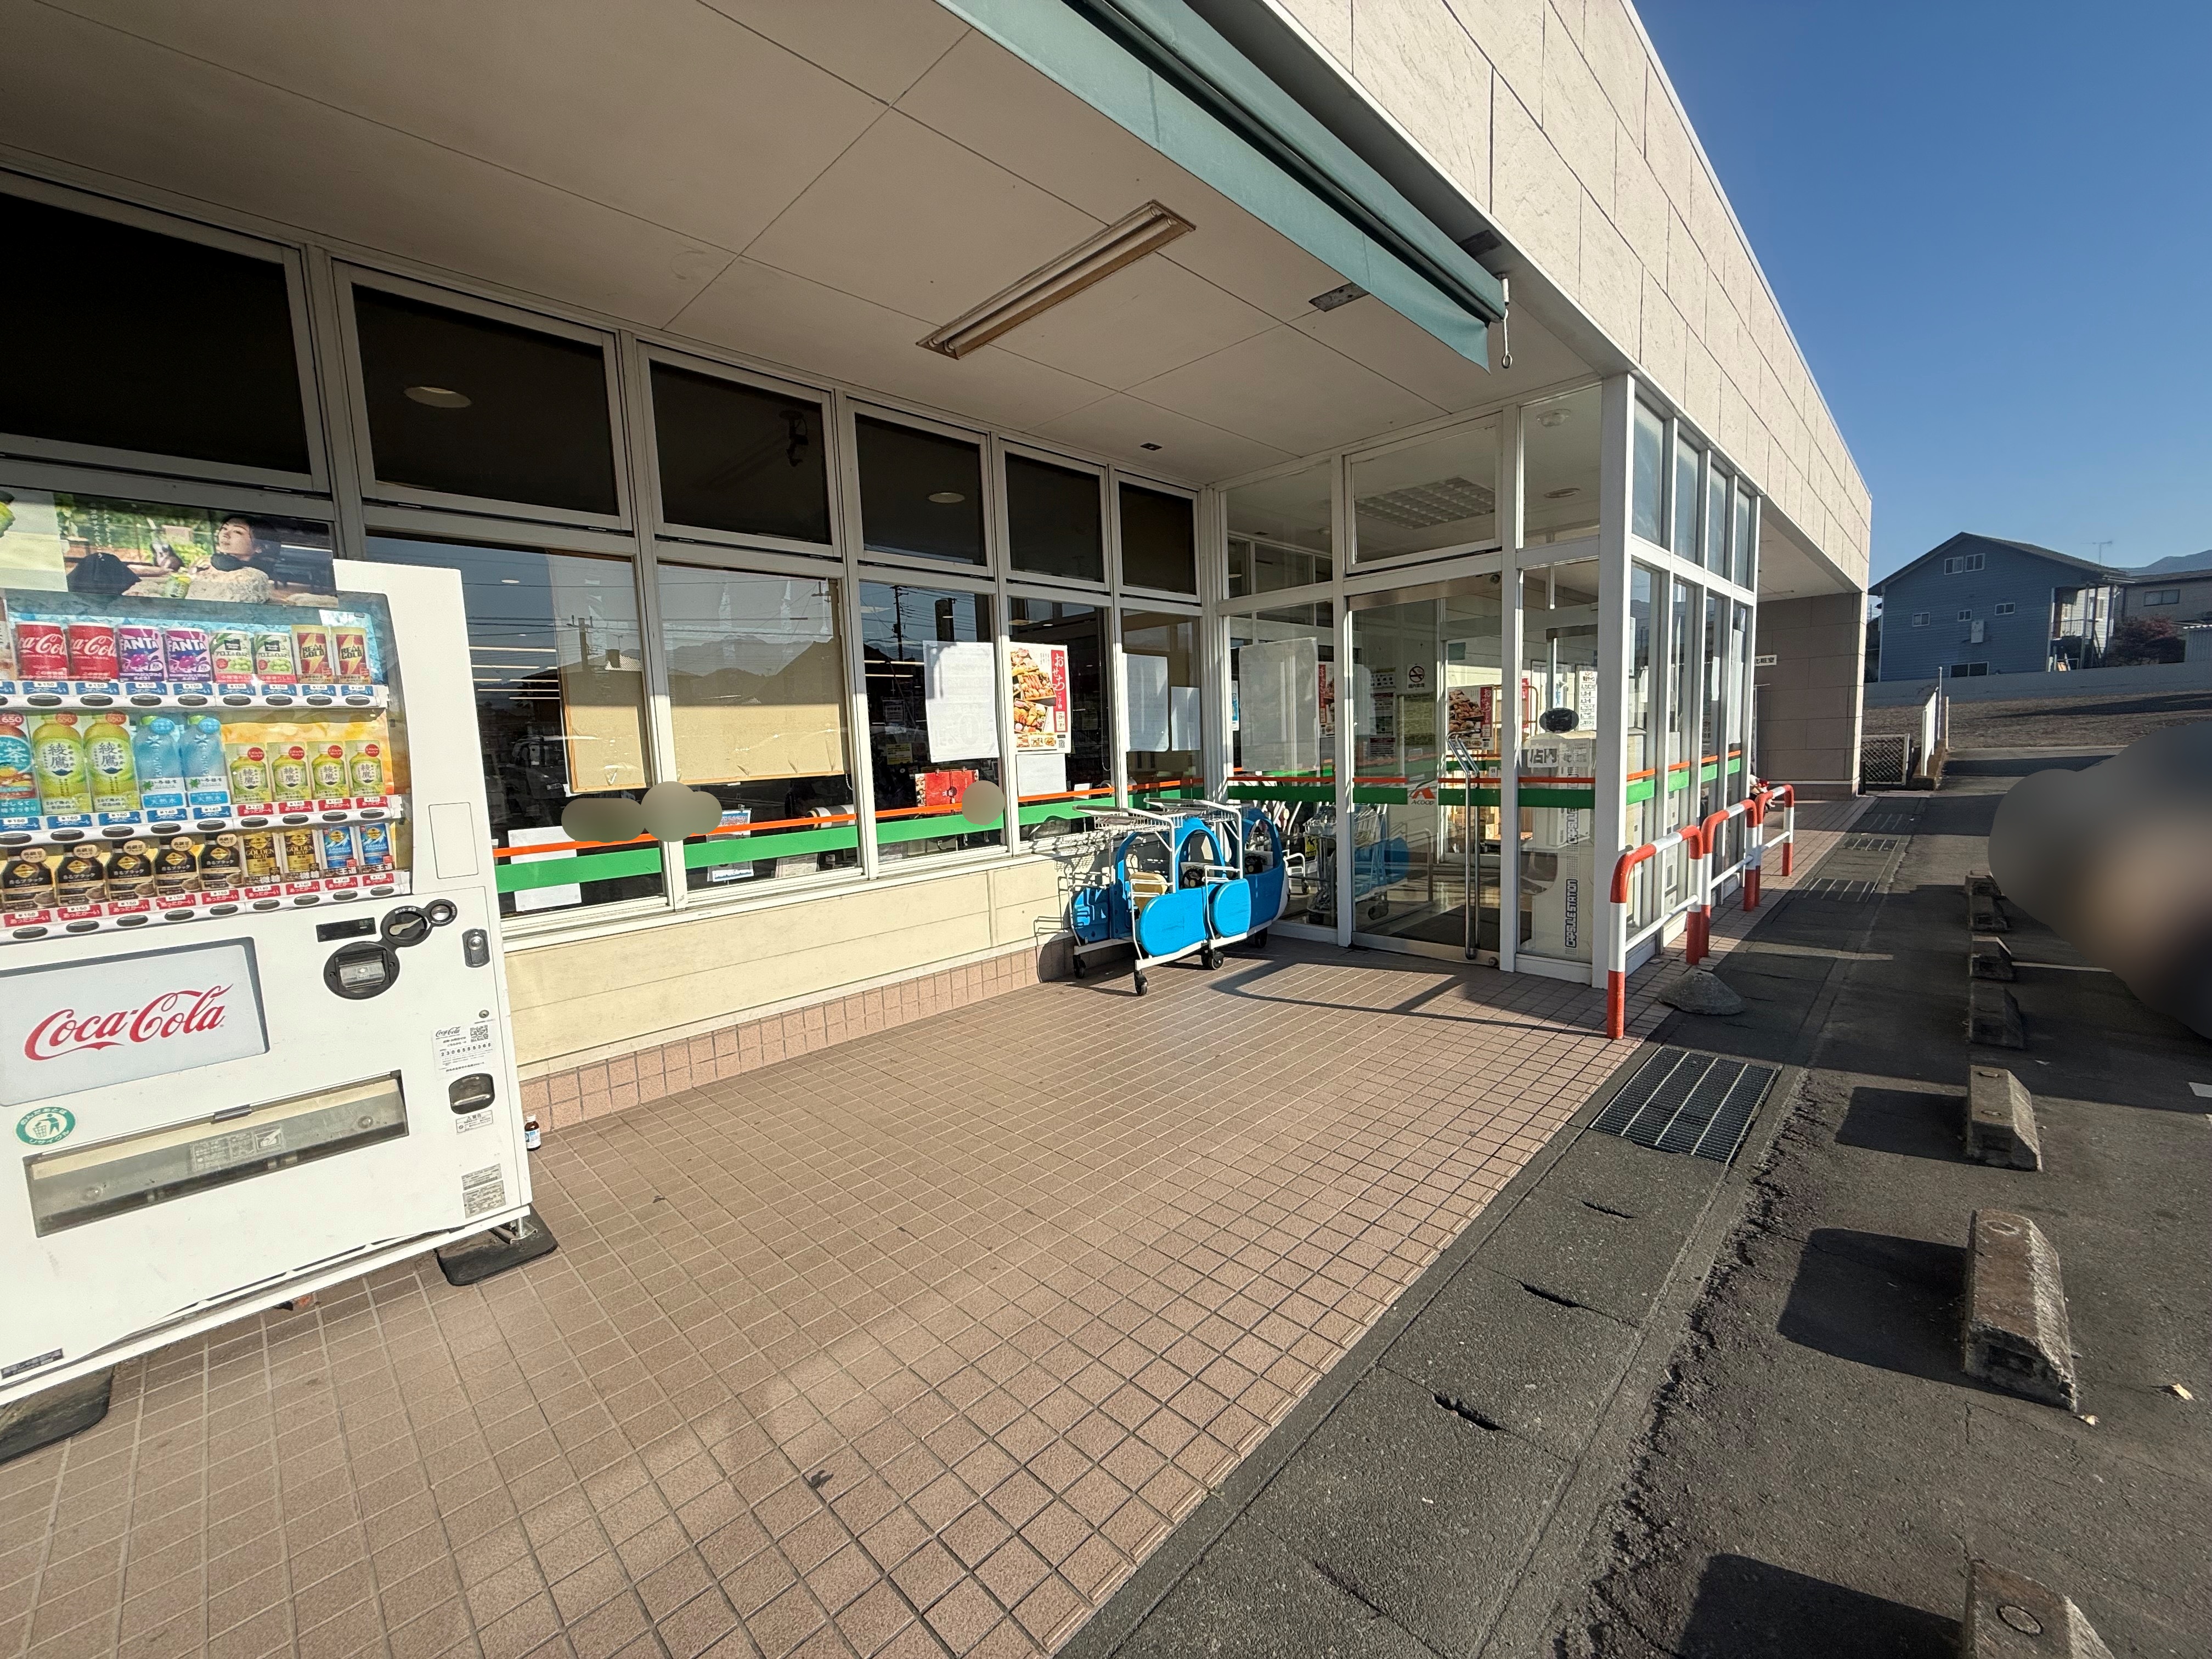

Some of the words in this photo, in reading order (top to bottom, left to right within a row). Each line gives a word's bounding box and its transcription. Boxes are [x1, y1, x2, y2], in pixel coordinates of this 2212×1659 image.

[302, 644, 323, 653] REAL
[303, 650, 324, 658] GOLD
[341, 645, 362, 654] REAL
[342, 650, 363, 659] GOLD
[1052, 653, 1065, 691] おせち
[1481, 688, 1492, 713] おせち
[48, 742, 69, 769] 綾鷹
[98, 741, 119, 767] 綾鷹
[337, 867, 357, 875] 王道
[375, 863, 393, 871] 王道
[24, 983, 234, 1061] Coca-Cola
[436, 1026, 461, 1037] Coca-Cola
[29, 1130, 69, 1144] リサイクル
